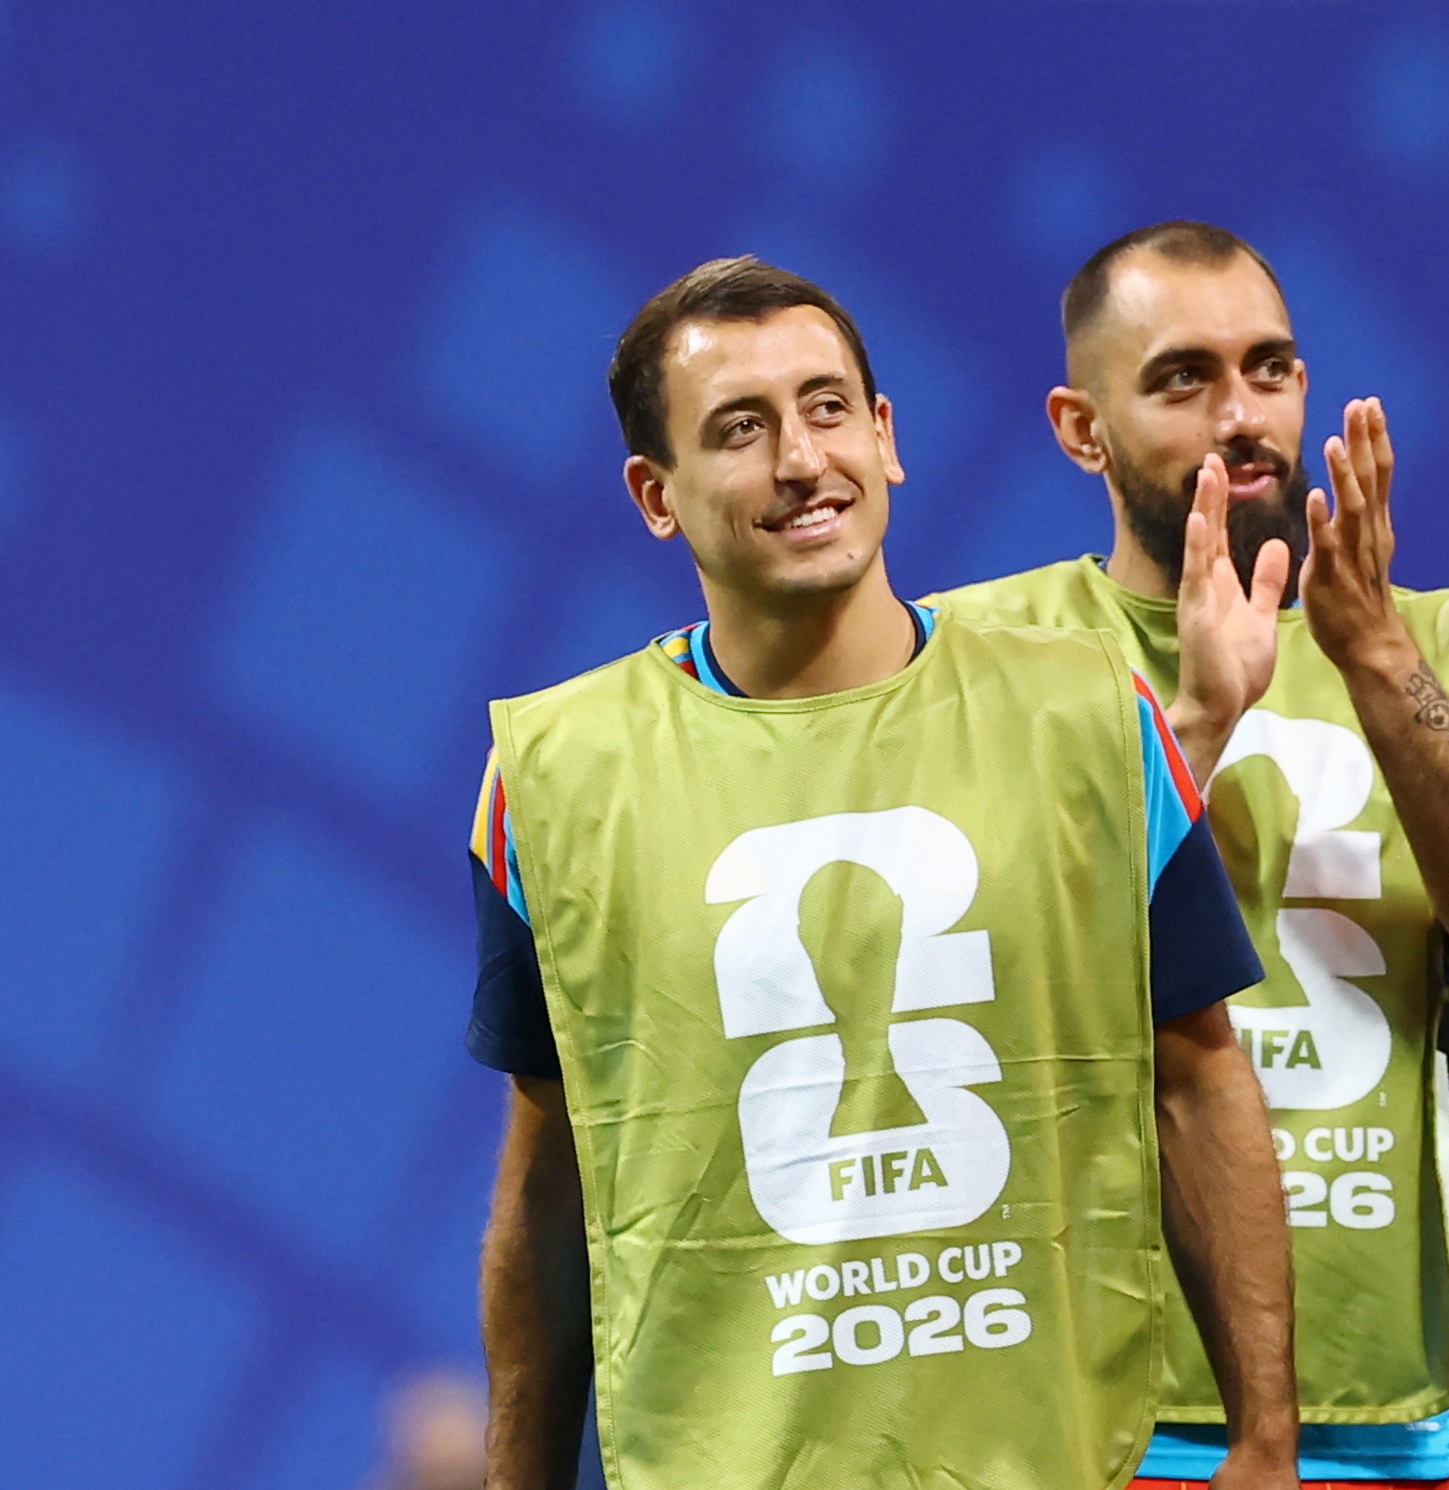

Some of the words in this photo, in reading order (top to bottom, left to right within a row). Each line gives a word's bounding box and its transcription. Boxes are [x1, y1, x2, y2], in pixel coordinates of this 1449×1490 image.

[829, 1147, 948, 1201] FIFA
[1304, 1127, 1395, 1163] CUP
[1281, 1170, 1395, 1229] 26
[765, 1252, 931, 1309] WORLD
[938, 1240, 1023, 1283] CUP
[770, 1288, 1032, 1376] 2026
